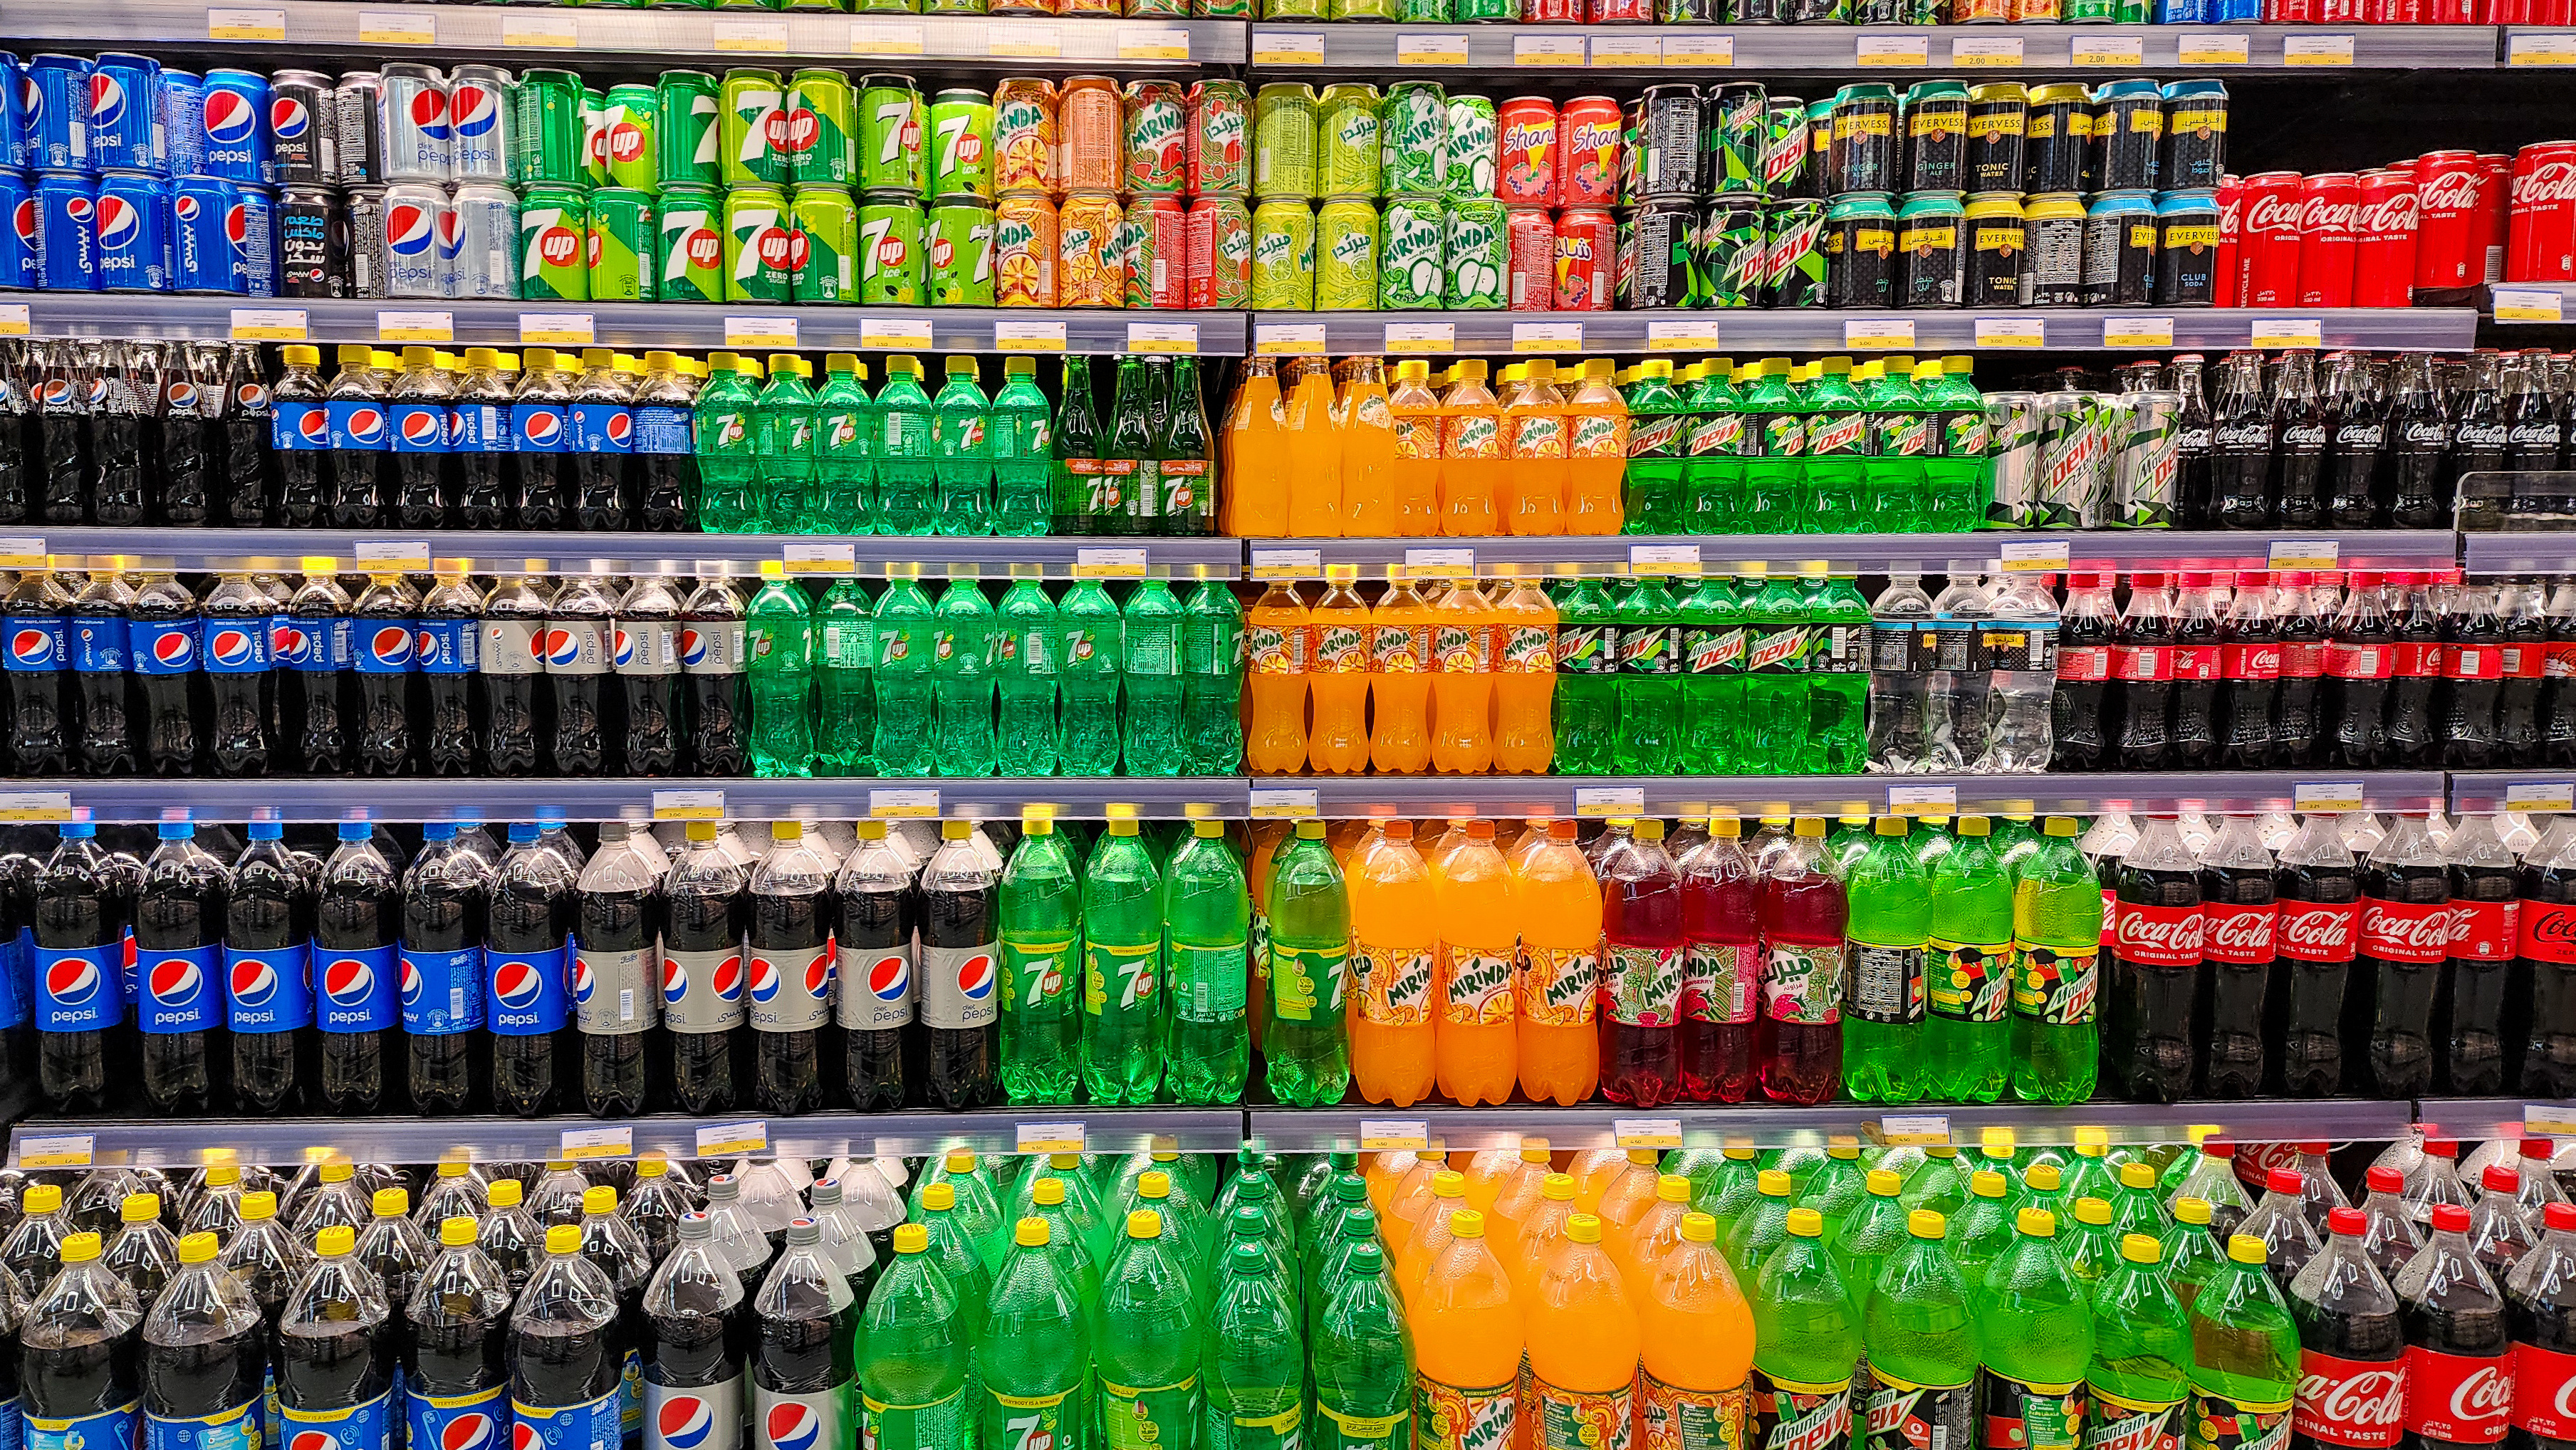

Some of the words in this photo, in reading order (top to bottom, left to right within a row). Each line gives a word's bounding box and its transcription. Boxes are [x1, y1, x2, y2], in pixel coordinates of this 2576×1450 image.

[1837, 120, 1887, 132] EVERVESS
[1912, 118, 1964, 130] EVERVESS
[1970, 120, 2021, 131] EVERVESS
[93, 133, 121, 148] epsi
[1503, 122, 1555, 156] Shani
[209, 150, 251, 164] pepsi
[276, 142, 306, 155] pepsi
[1841, 163, 1878, 173] GINGER
[1917, 162, 1955, 170] GINGER
[1976, 163, 2008, 172] TONIC
[285, 216, 323, 226] طعم
[2169, 232, 2219, 241] EVERVESS
[285, 239, 324, 252] بدون
[439, 413, 449, 445] pepsi
[466, 411, 478, 444] pepsi
[1518, 421, 1558, 446] MIRINDA
[1575, 421, 1615, 446] MIRINDA
[2215, 426, 2267, 444] Coca-Cola
[2283, 424, 2326, 444] Coca-Cola
[56, 630, 66, 662] pepsi
[255, 630, 264, 663] pepsi
[311, 630, 325, 662] pepsi
[441, 632, 453, 664] pepsi
[585, 629, 598, 664] pepsi
[641, 630, 651, 665] pepsi
[713, 630, 724, 665] pepsi
[1318, 631, 1362, 659] MIRINDA
[1506, 631, 1550, 659] MIRINDA
[1689, 630, 1741, 657] Mountain
[1749, 629, 1794, 654] Mountain
[2134, 951, 2176, 960] ORIGINAL
[2373, 945, 2416, 956] ORIGINAL
[1449, 959, 1512, 1003] MIRINDA
[1483, 983, 1507, 996] ORANGE
[52, 1008, 96, 1023] pepsi
[155, 1009, 199, 1025] pepsi
[234, 1010, 273, 1025] pepsi
[329, 1008, 370, 1023] pepsi
[499, 1011, 538, 1027] pepsi
[664, 1011, 686, 1025] epsi
[874, 1006, 908, 1024] pepsi
[962, 1006, 994, 1023] pepsi
[1771, 1395, 1840, 1446] Mountain
[2090, 1414, 2146, 1445] Mountain
[2344, 1430, 2387, 1440] TASTE
